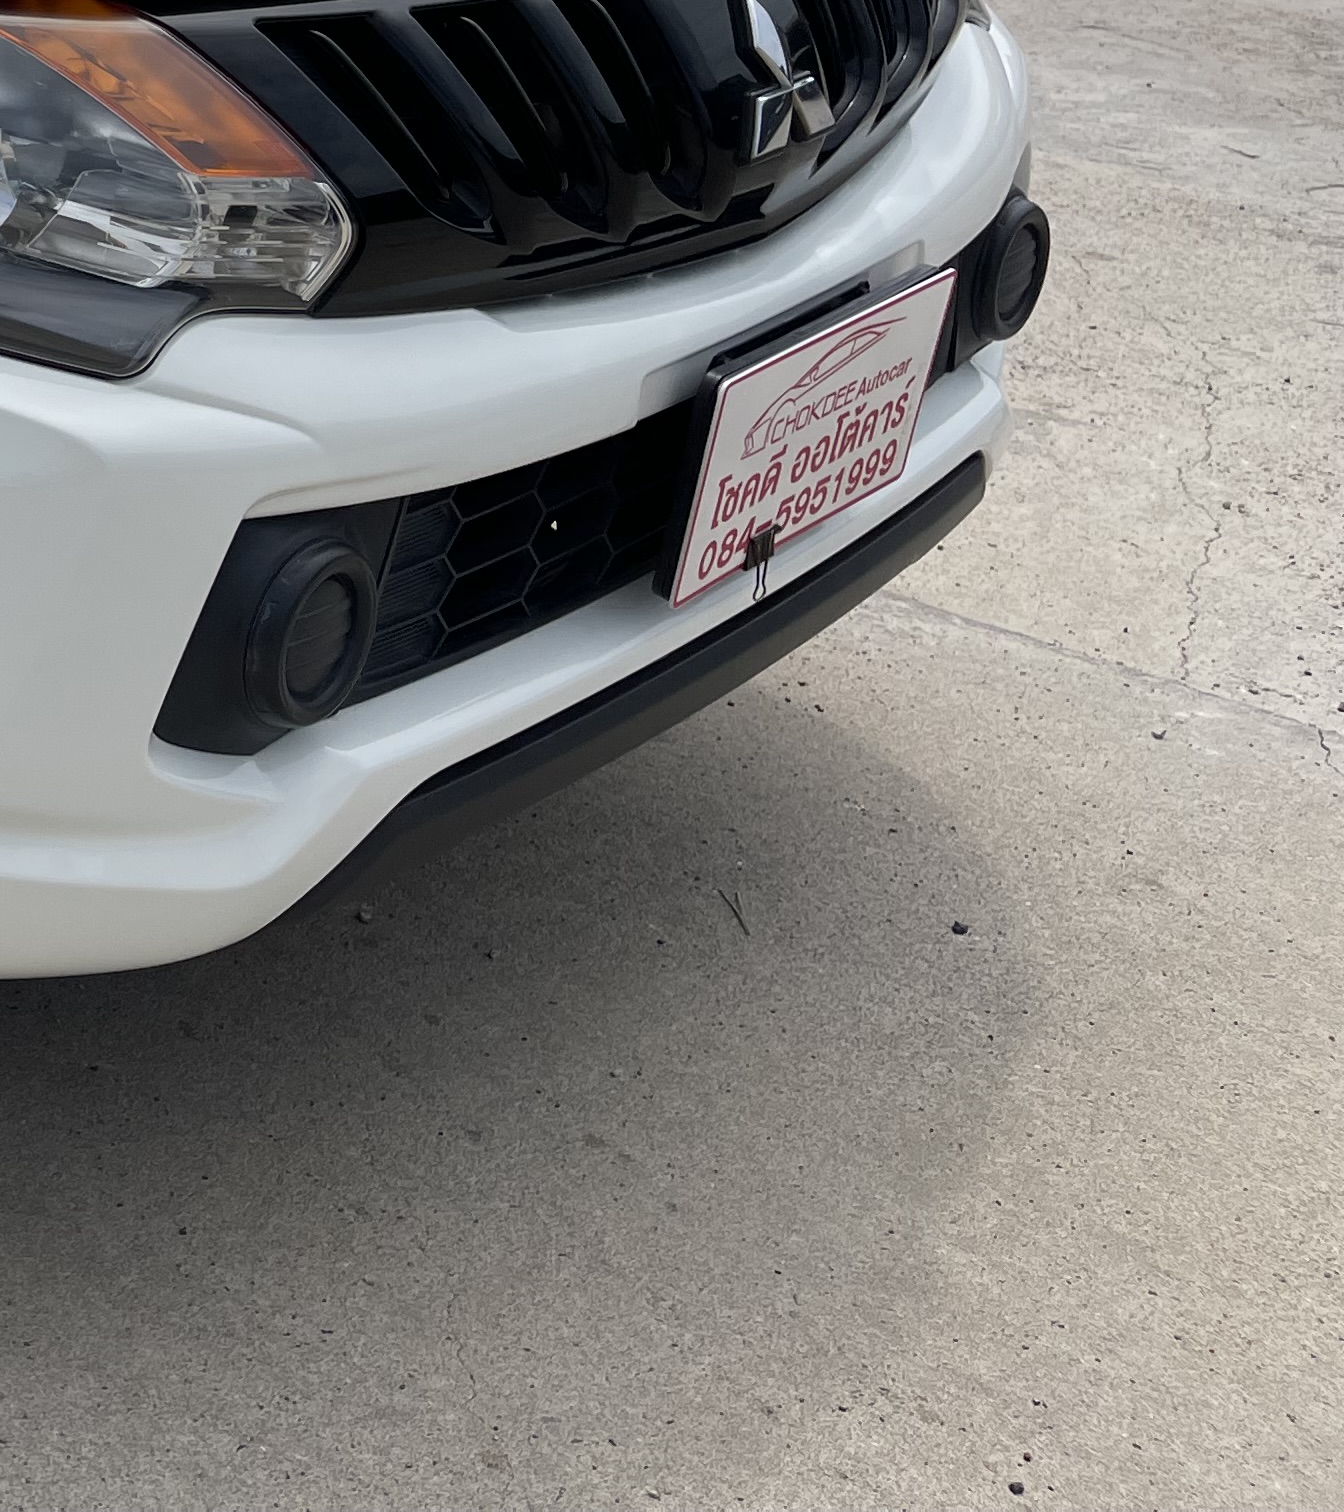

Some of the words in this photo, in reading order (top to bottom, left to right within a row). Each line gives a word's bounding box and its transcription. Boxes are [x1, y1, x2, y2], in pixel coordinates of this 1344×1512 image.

[711, 444, 788, 530] โชคดี
[791, 375, 916, 484] ออโต้คาร์
[770, 379, 859, 445] CHOKDEE
[856, 357, 913, 399] Autocar
